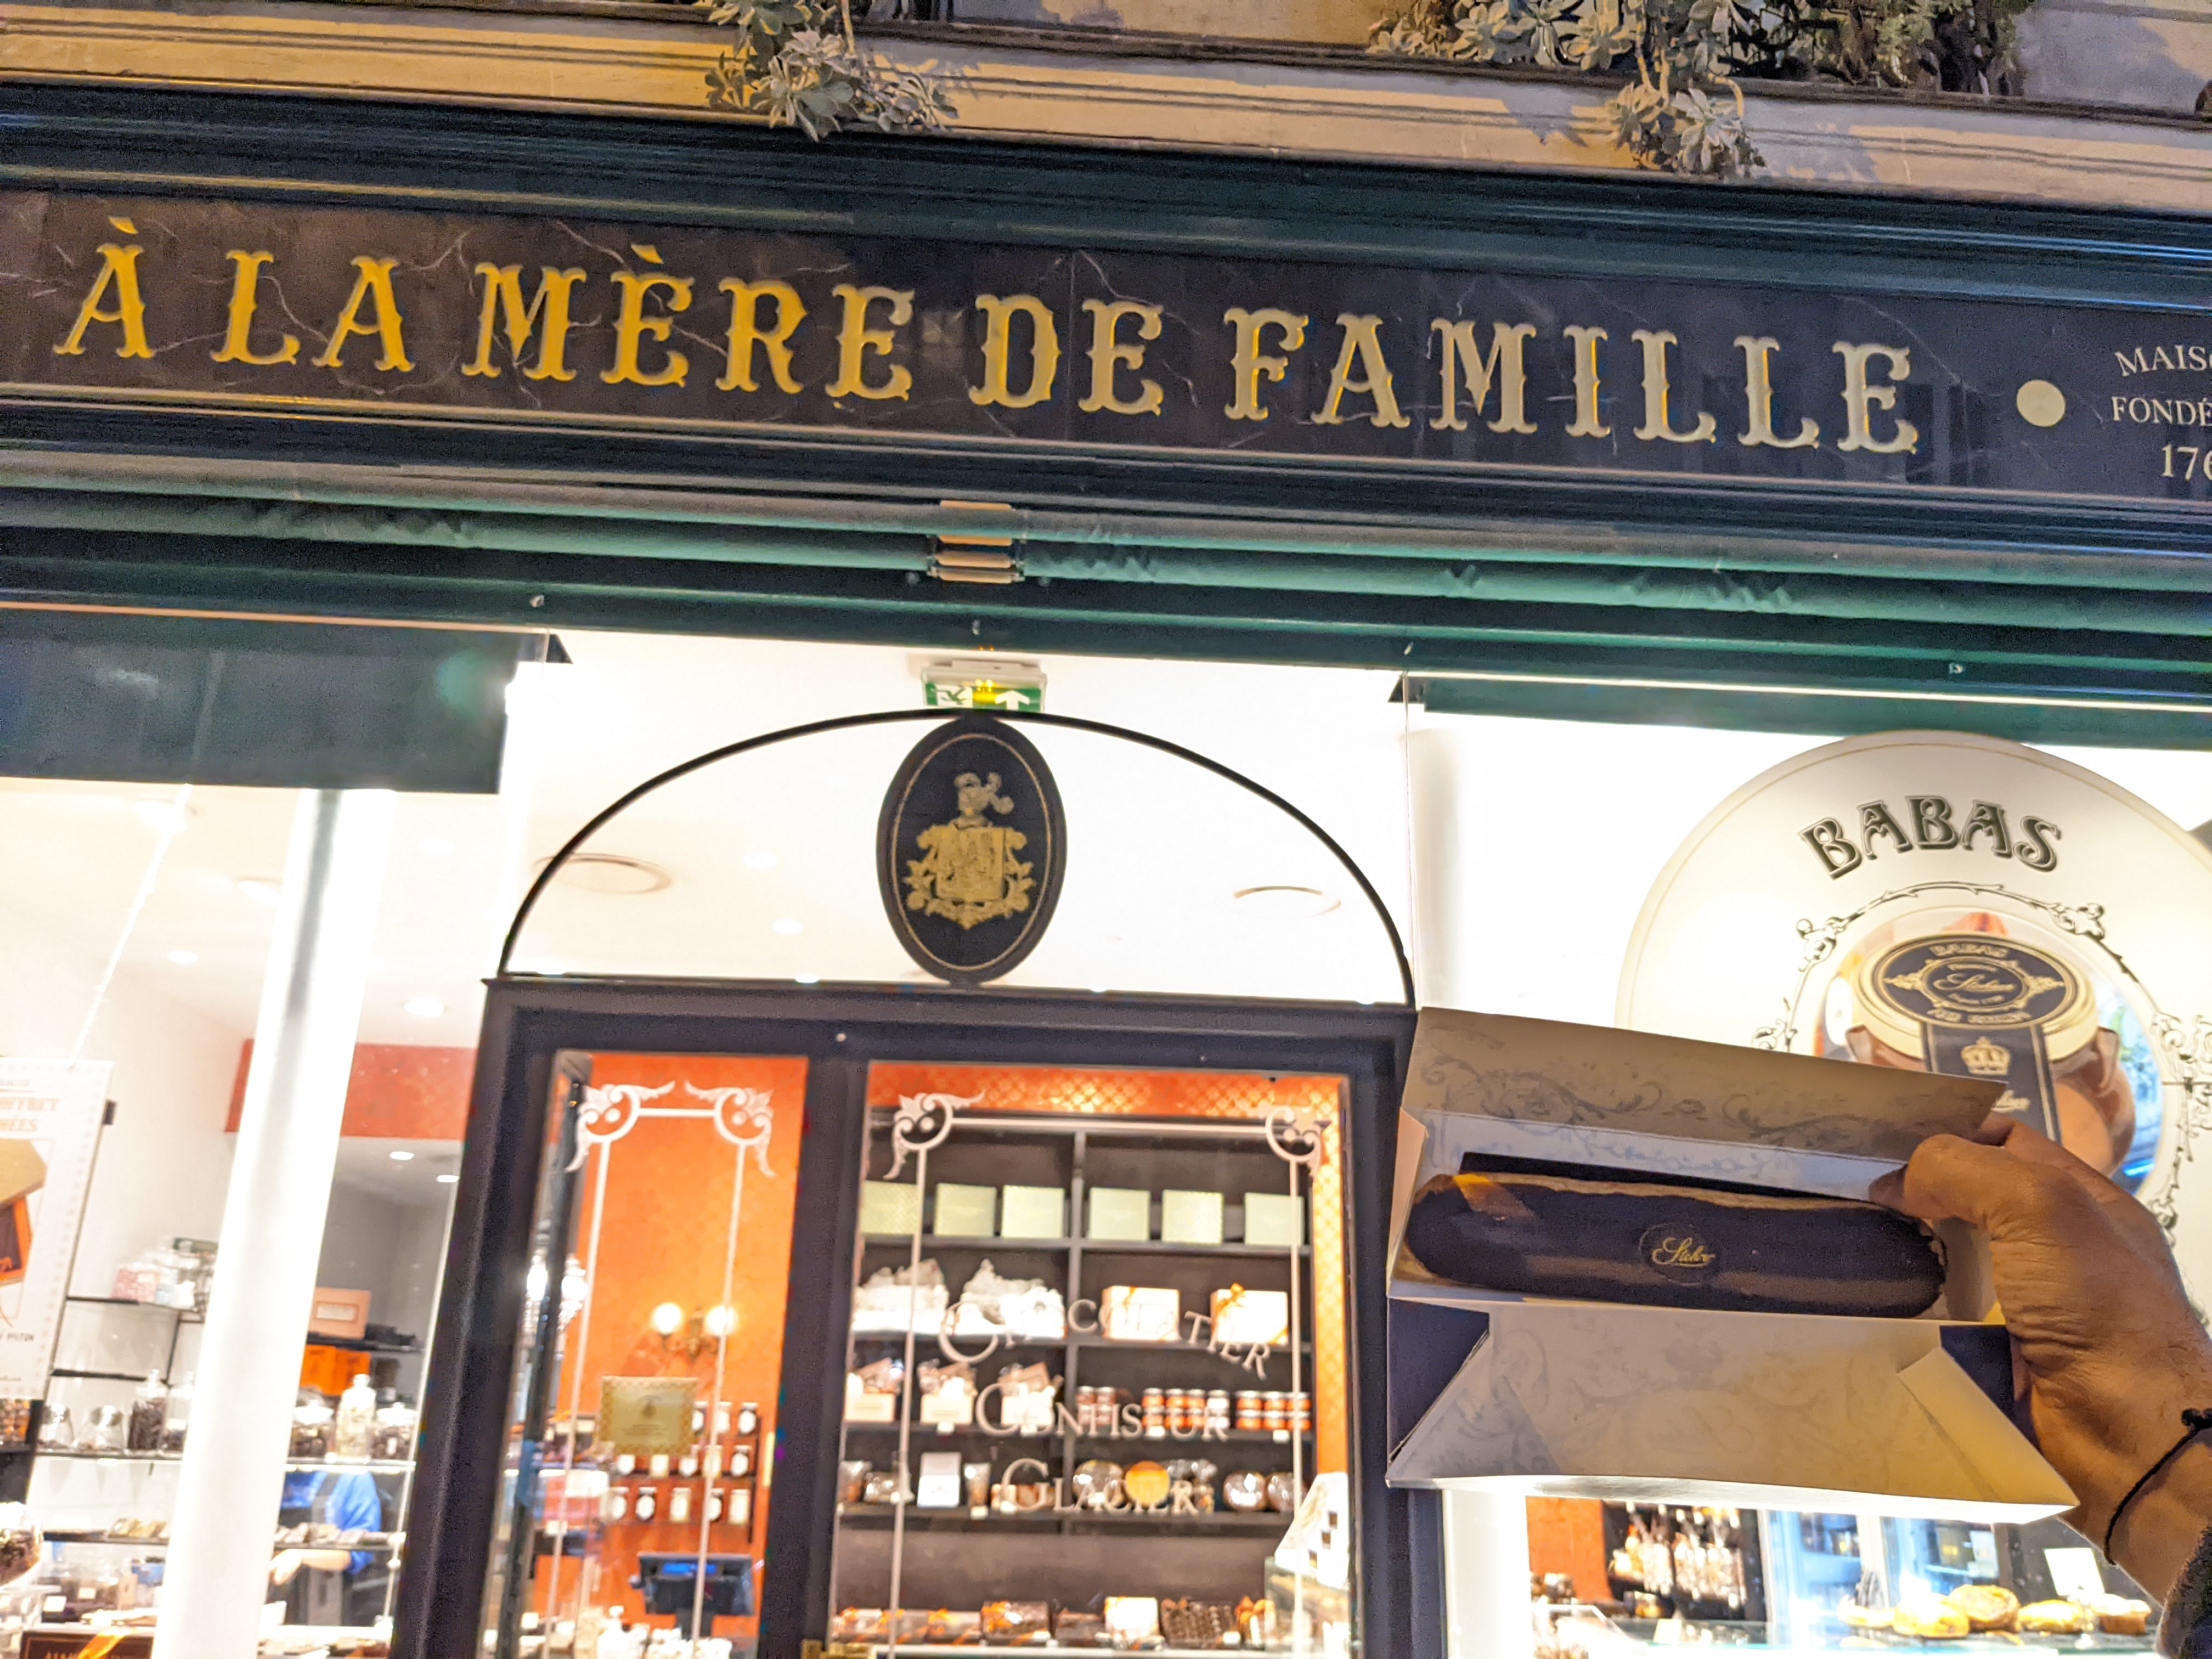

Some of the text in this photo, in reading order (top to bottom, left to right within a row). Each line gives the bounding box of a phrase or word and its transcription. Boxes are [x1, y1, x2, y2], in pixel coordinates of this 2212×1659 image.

[53, 216, 1918, 455] À LA MÈRE DE FAMILLE
[2115, 345, 2212, 377] MAIS
[1797, 795, 2061, 881] BABAS
[975, 1382, 1231, 1442] CONFISUR
